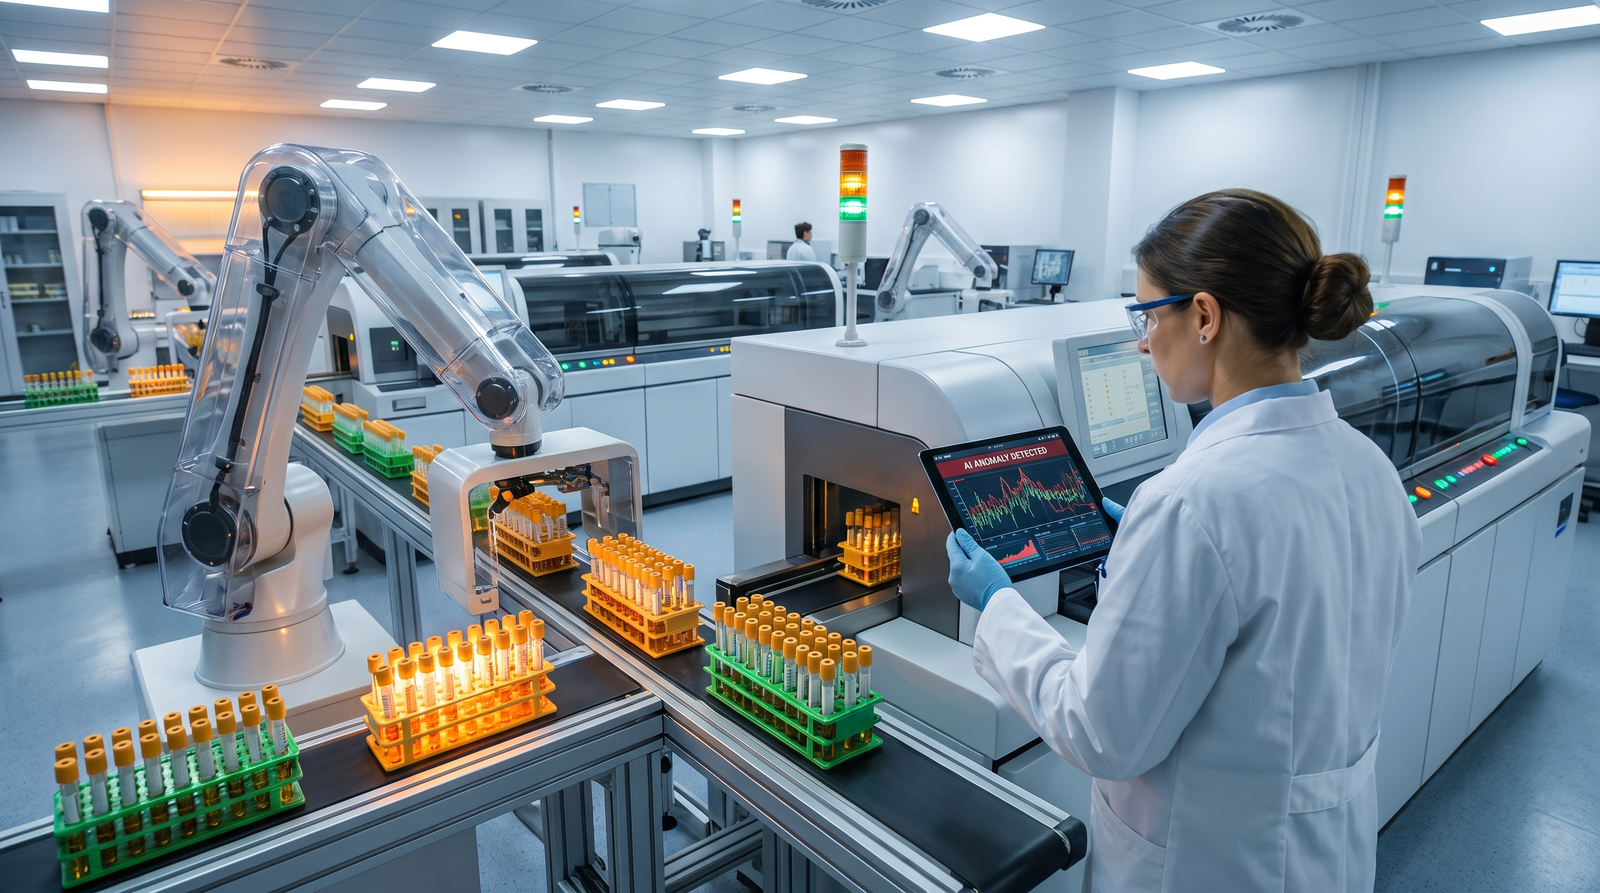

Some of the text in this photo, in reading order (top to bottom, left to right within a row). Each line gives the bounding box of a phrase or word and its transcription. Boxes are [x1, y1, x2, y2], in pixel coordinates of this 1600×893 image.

[964, 461, 973, 470] AI
[974, 453, 1009, 467] ANOMALY
[1010, 446, 1048, 460] DETECTED
